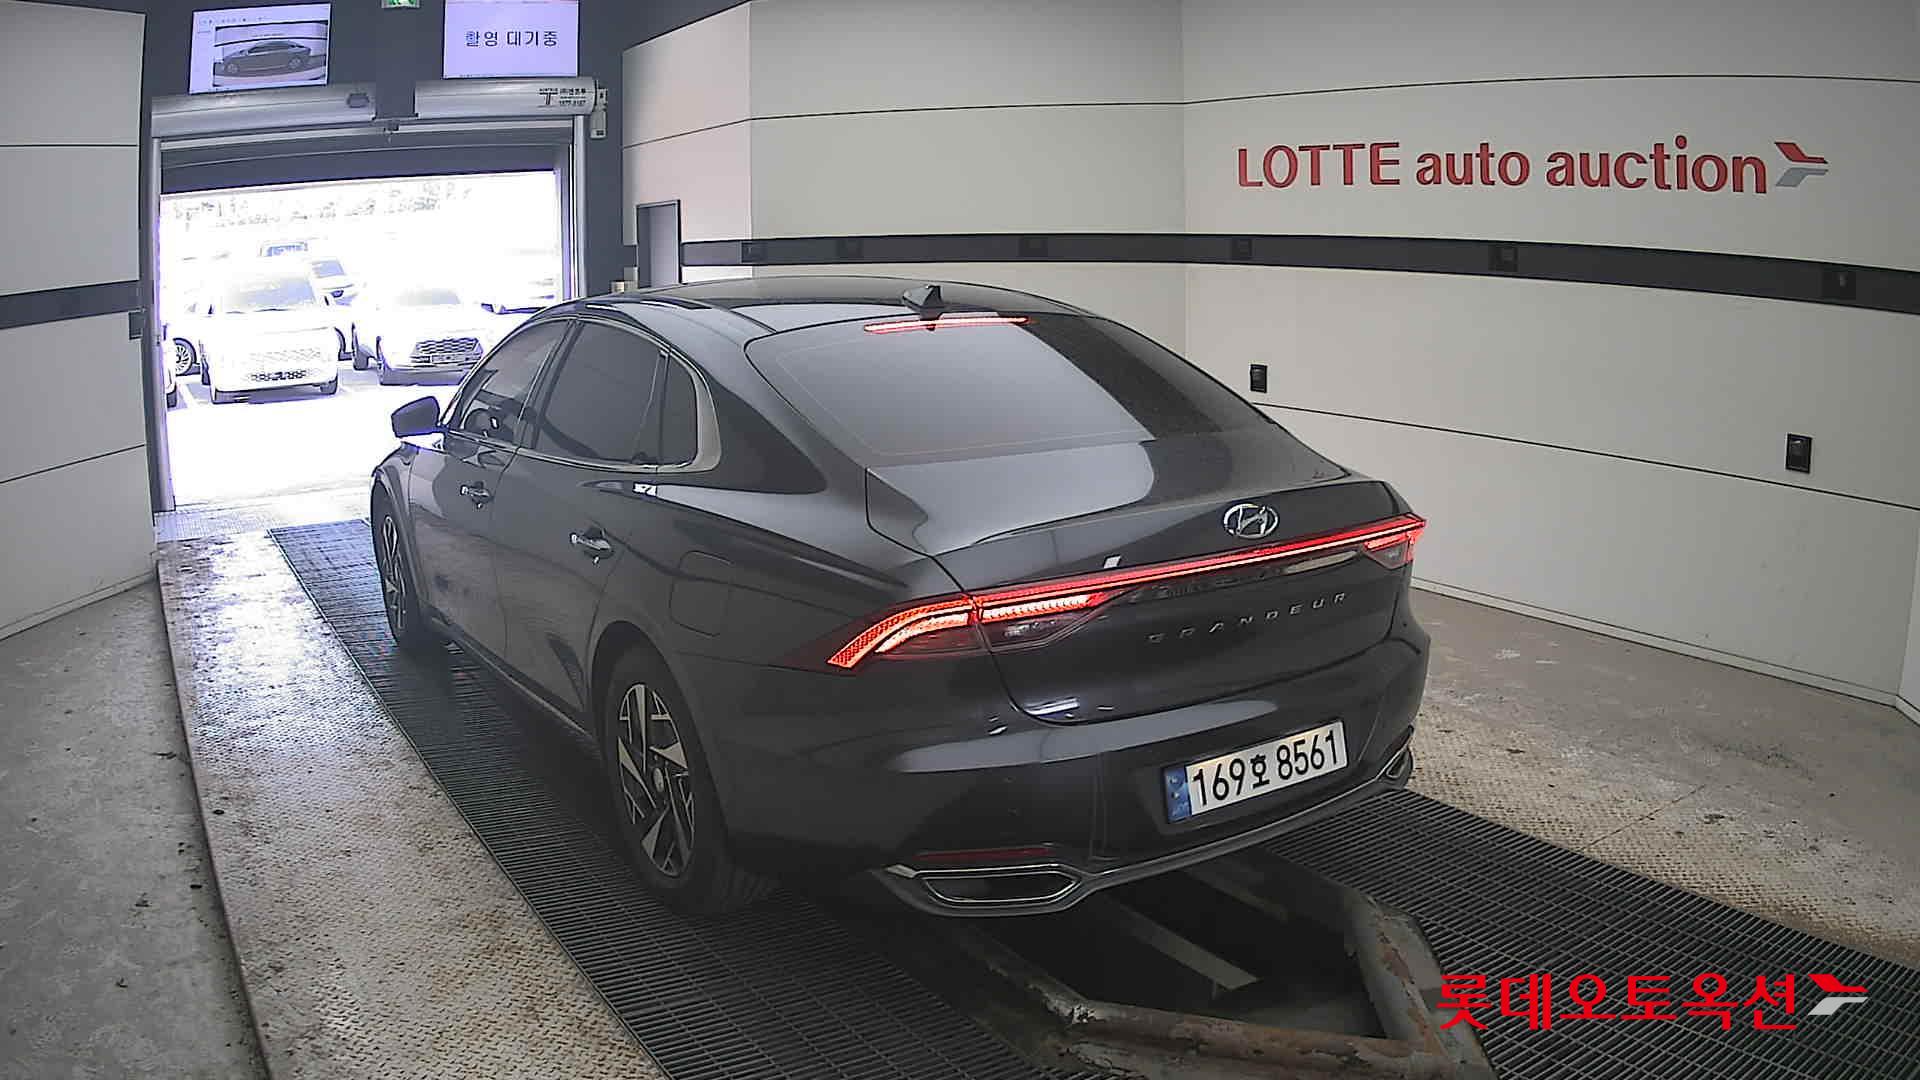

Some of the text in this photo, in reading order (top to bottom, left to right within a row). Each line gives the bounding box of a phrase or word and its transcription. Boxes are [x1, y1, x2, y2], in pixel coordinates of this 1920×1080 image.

[1237, 134, 1767, 194] LOTTE auto auction
[1148, 591, 1346, 644] GRANDEUR
[1192, 729, 1339, 808] 169호 8561
